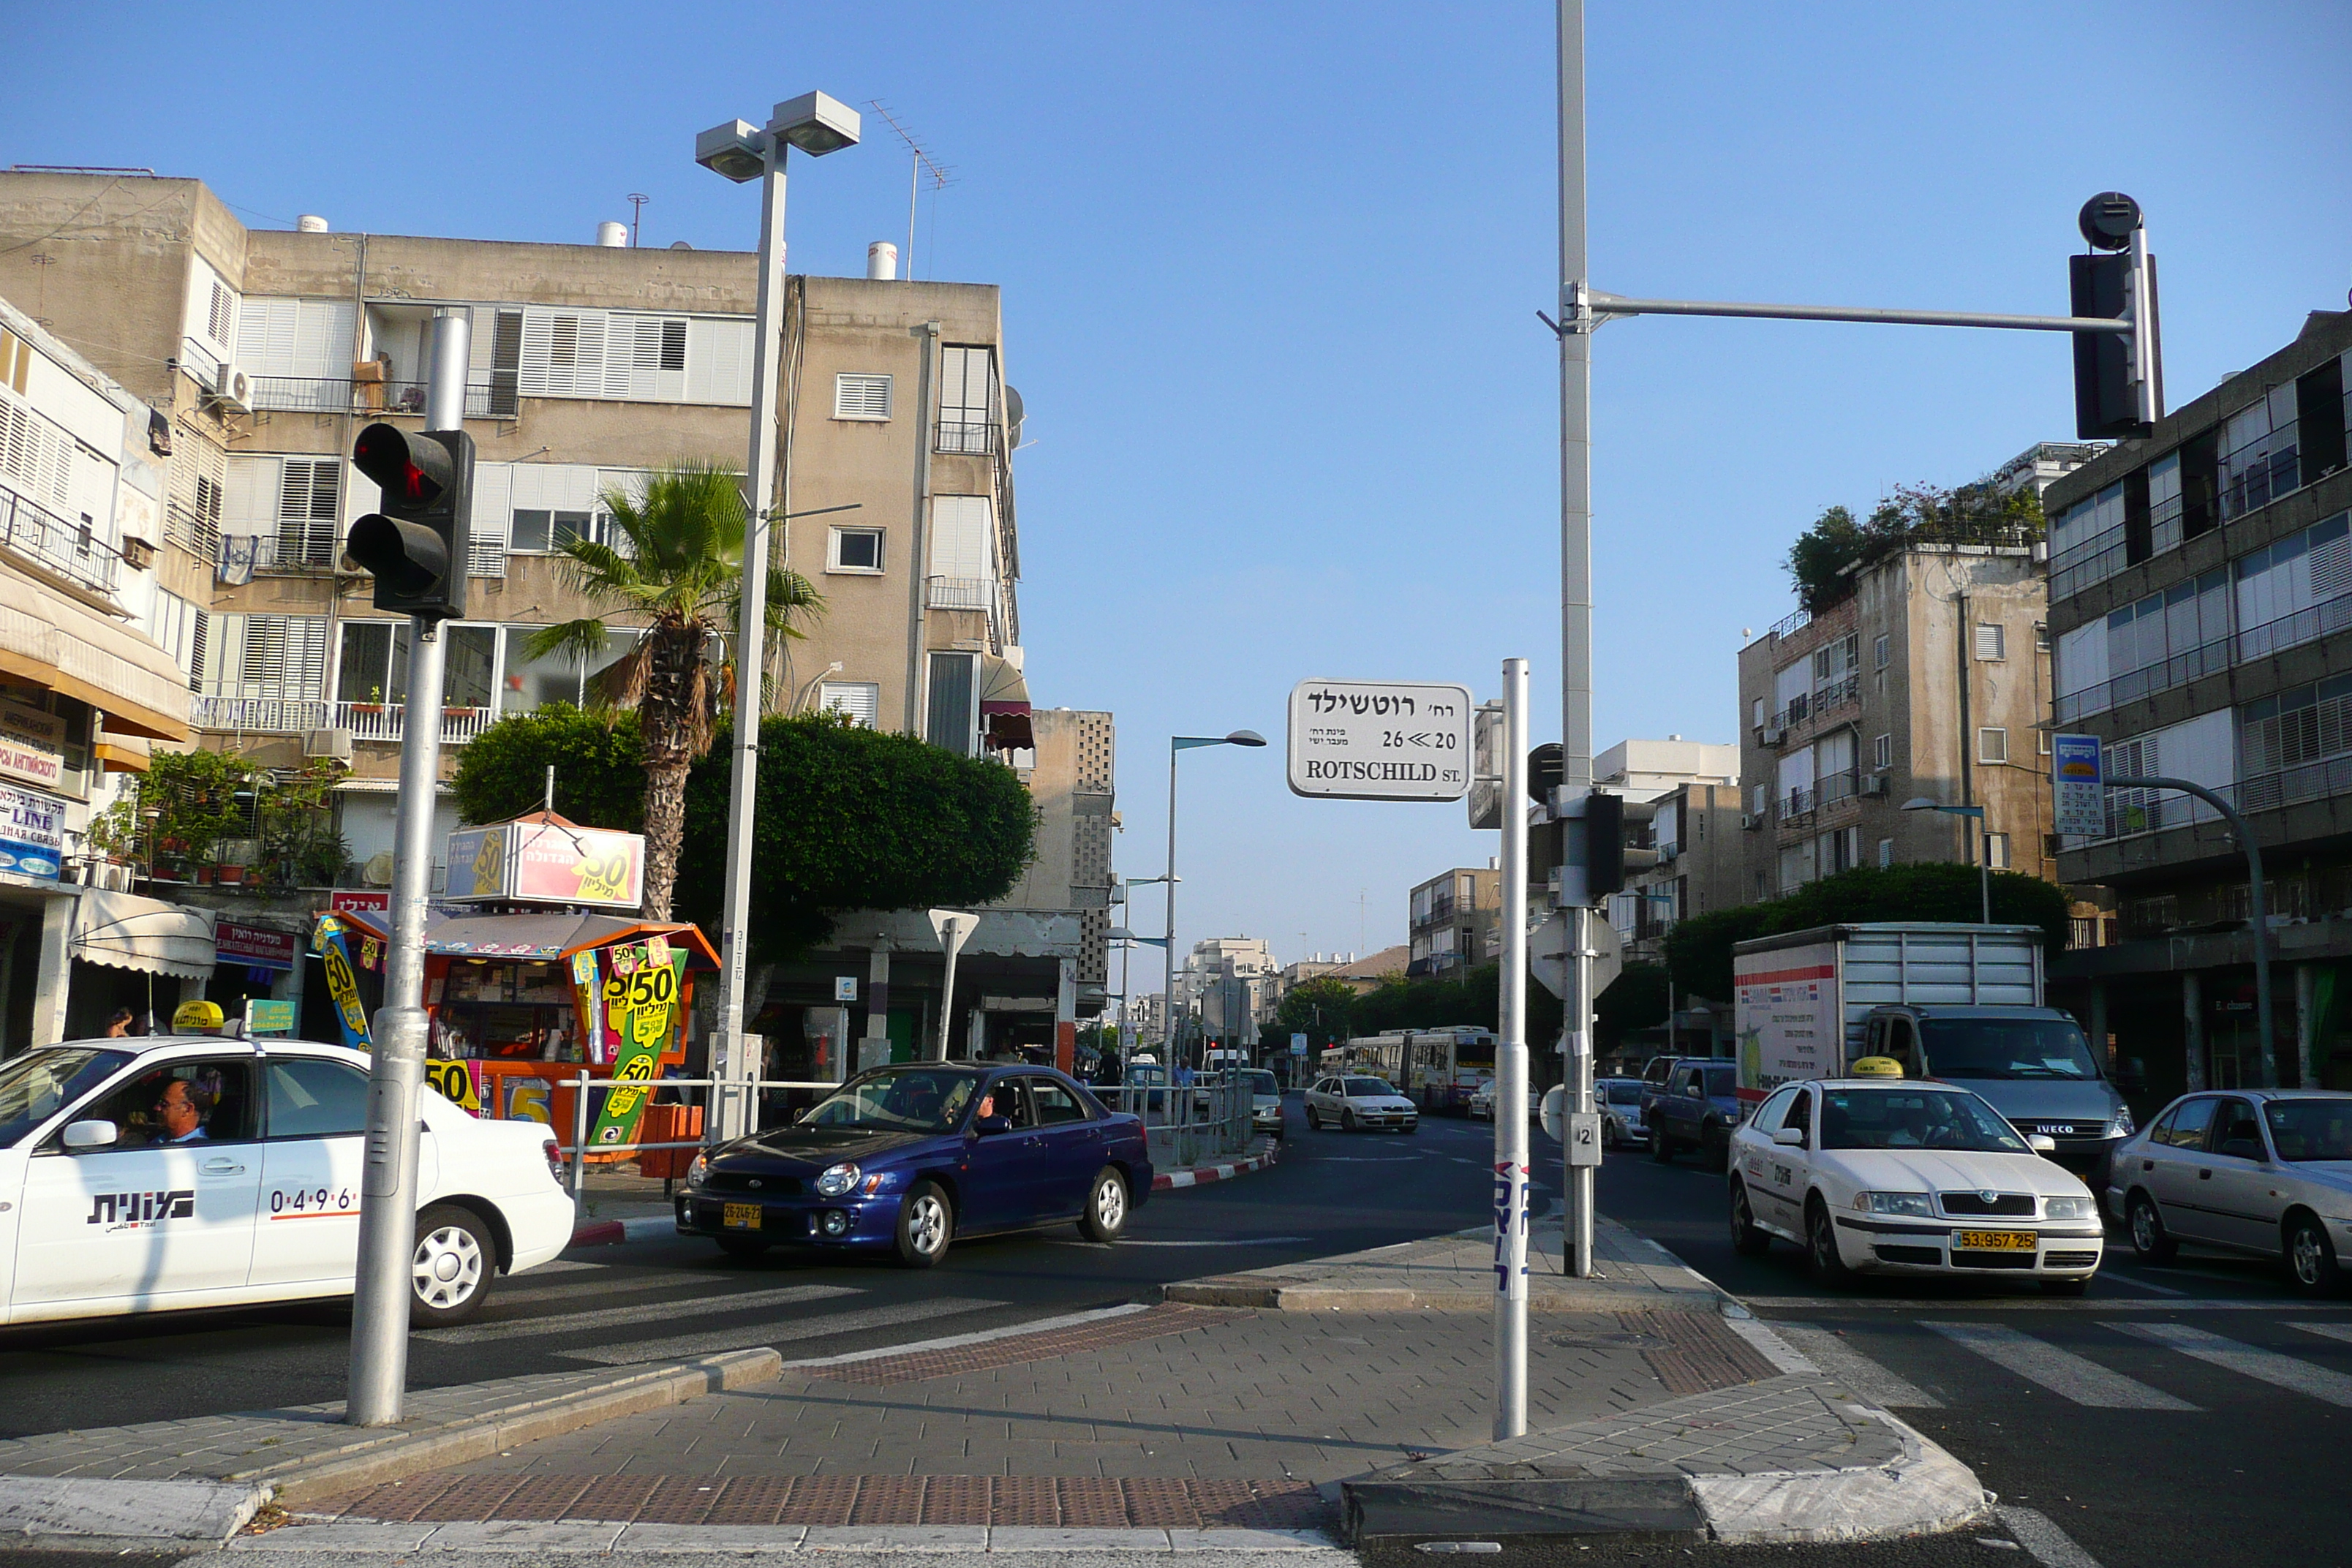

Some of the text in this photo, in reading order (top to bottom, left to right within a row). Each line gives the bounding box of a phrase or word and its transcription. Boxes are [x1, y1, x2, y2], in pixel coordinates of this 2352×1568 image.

[1307, 688, 1415, 717] רוטשילד
[1325, 728, 1346, 736] פינת
[1305, 761, 1461, 783] ROTSCHILD ST.
[28, 797, 64, 815] תקשורת
[12, 807, 53, 832] LINE
[31, 832, 61, 847] СВЯЗЬ
[478, 839, 500, 880] 50
[526, 851, 575, 864] הגדולה
[581, 876, 614, 898] מיליון
[364, 941, 376, 954] 50
[614, 947, 630, 960] 50
[325, 954, 351, 992] 50
[633, 968, 673, 1006] 50
[637, 1002, 668, 1017] מיליון
[638, 1021, 651, 1038] 5
[2037, 1125, 2074, 1134] IVECO
[87, 1190, 195, 1224] מונית
